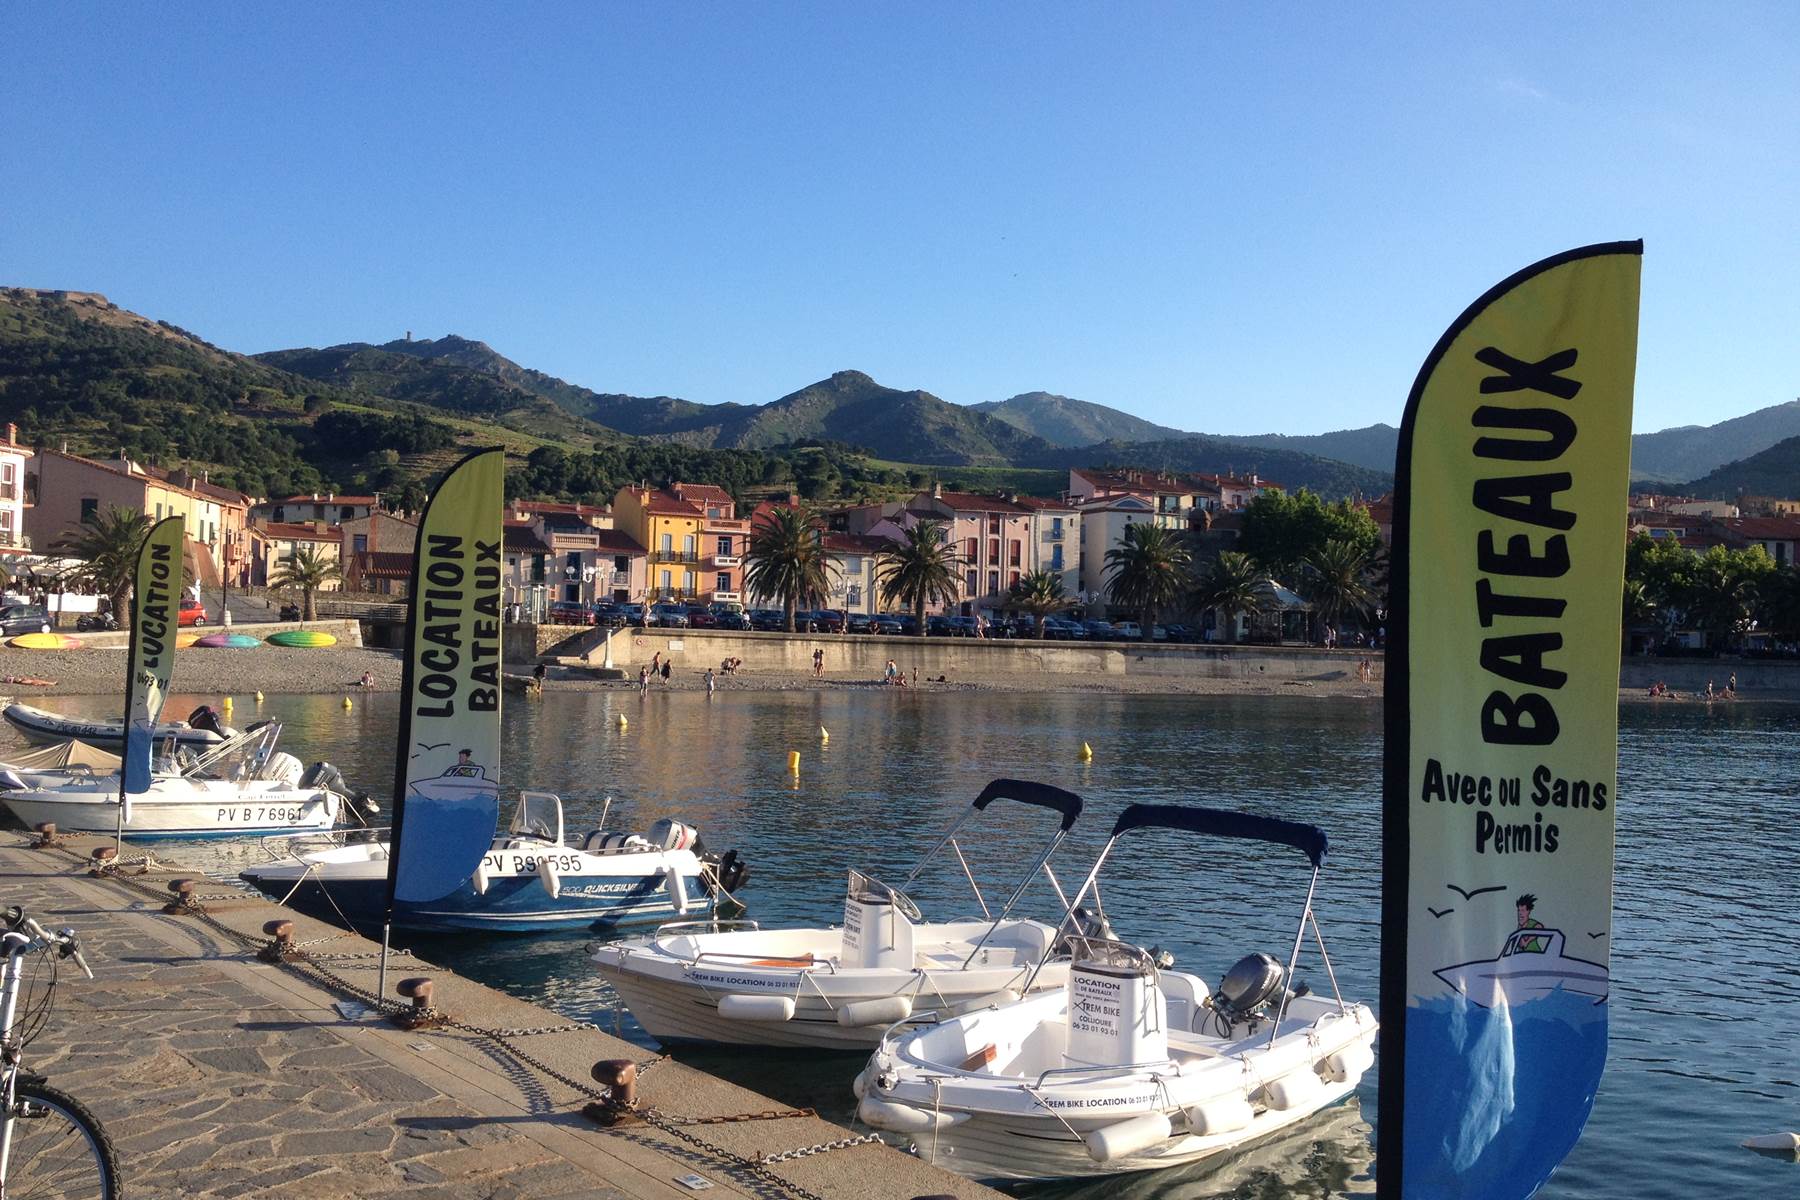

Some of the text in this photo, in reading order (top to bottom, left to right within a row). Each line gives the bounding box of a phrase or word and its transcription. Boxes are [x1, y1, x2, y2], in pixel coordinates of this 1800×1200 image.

[1471, 346, 1583, 746] BATEAUX
[417, 534, 464, 718] LOCATION
[468, 540, 500, 712] BATEAUX
[1421, 758, 1607, 811] Avec ou Sans
[218, 808, 236, 822] PV
[243, 808, 252, 821] B
[1475, 811, 1559, 855] Permis
[484, 854, 503, 872] PV
[710, 974, 724, 983] BIKE
[727, 977, 766, 987] LOCATION
[1074, 976, 1120, 990] LOCATION
[1103, 1006, 1120, 1017] BIKE
[1073, 1021, 1080, 1029] 06
[1081, 1023, 1089, 1031] 23
[1079, 1015, 1112, 1027] COLLIOURE
[1067, 1099, 1083, 1108] BIKE
[1086, 1097, 1127, 1107] LOCATION
